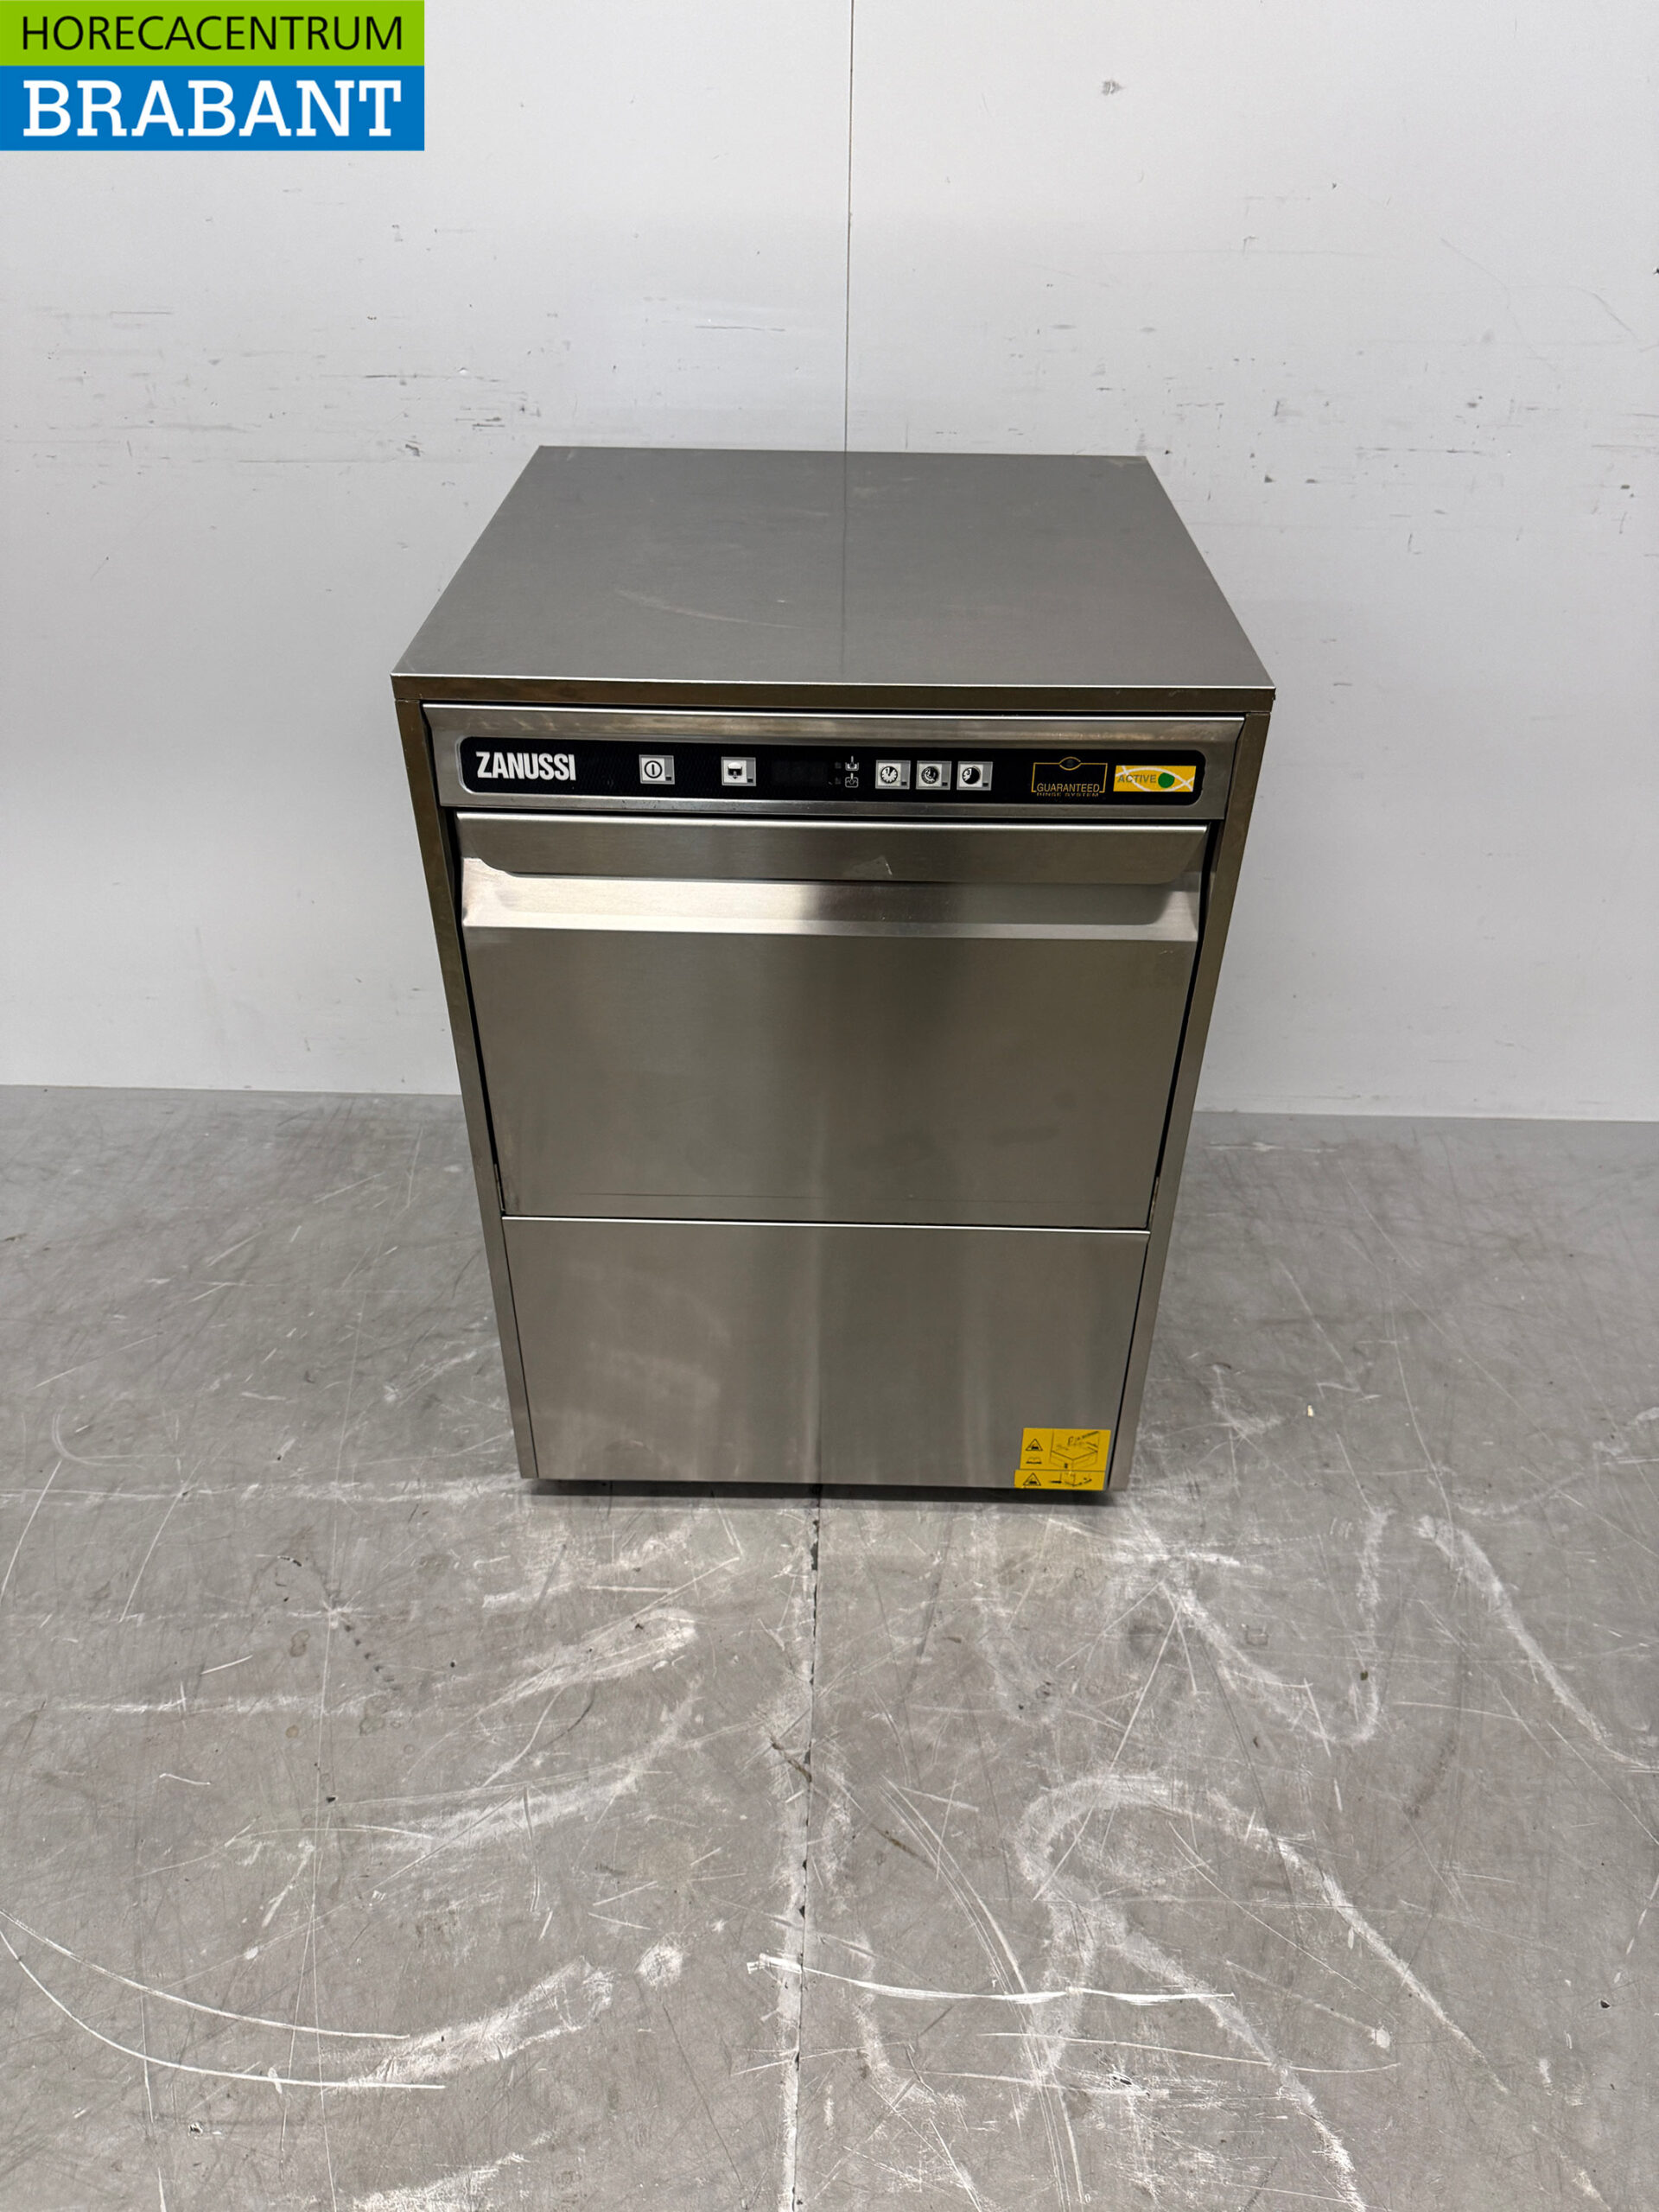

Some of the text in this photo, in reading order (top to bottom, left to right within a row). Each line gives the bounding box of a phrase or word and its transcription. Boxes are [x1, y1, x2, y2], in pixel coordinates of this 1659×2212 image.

[475, 751, 576, 781] ZANUSSI
[1117, 774, 1156, 784] ACTIVE
[1036, 783, 1100, 792] GUARANTEED
